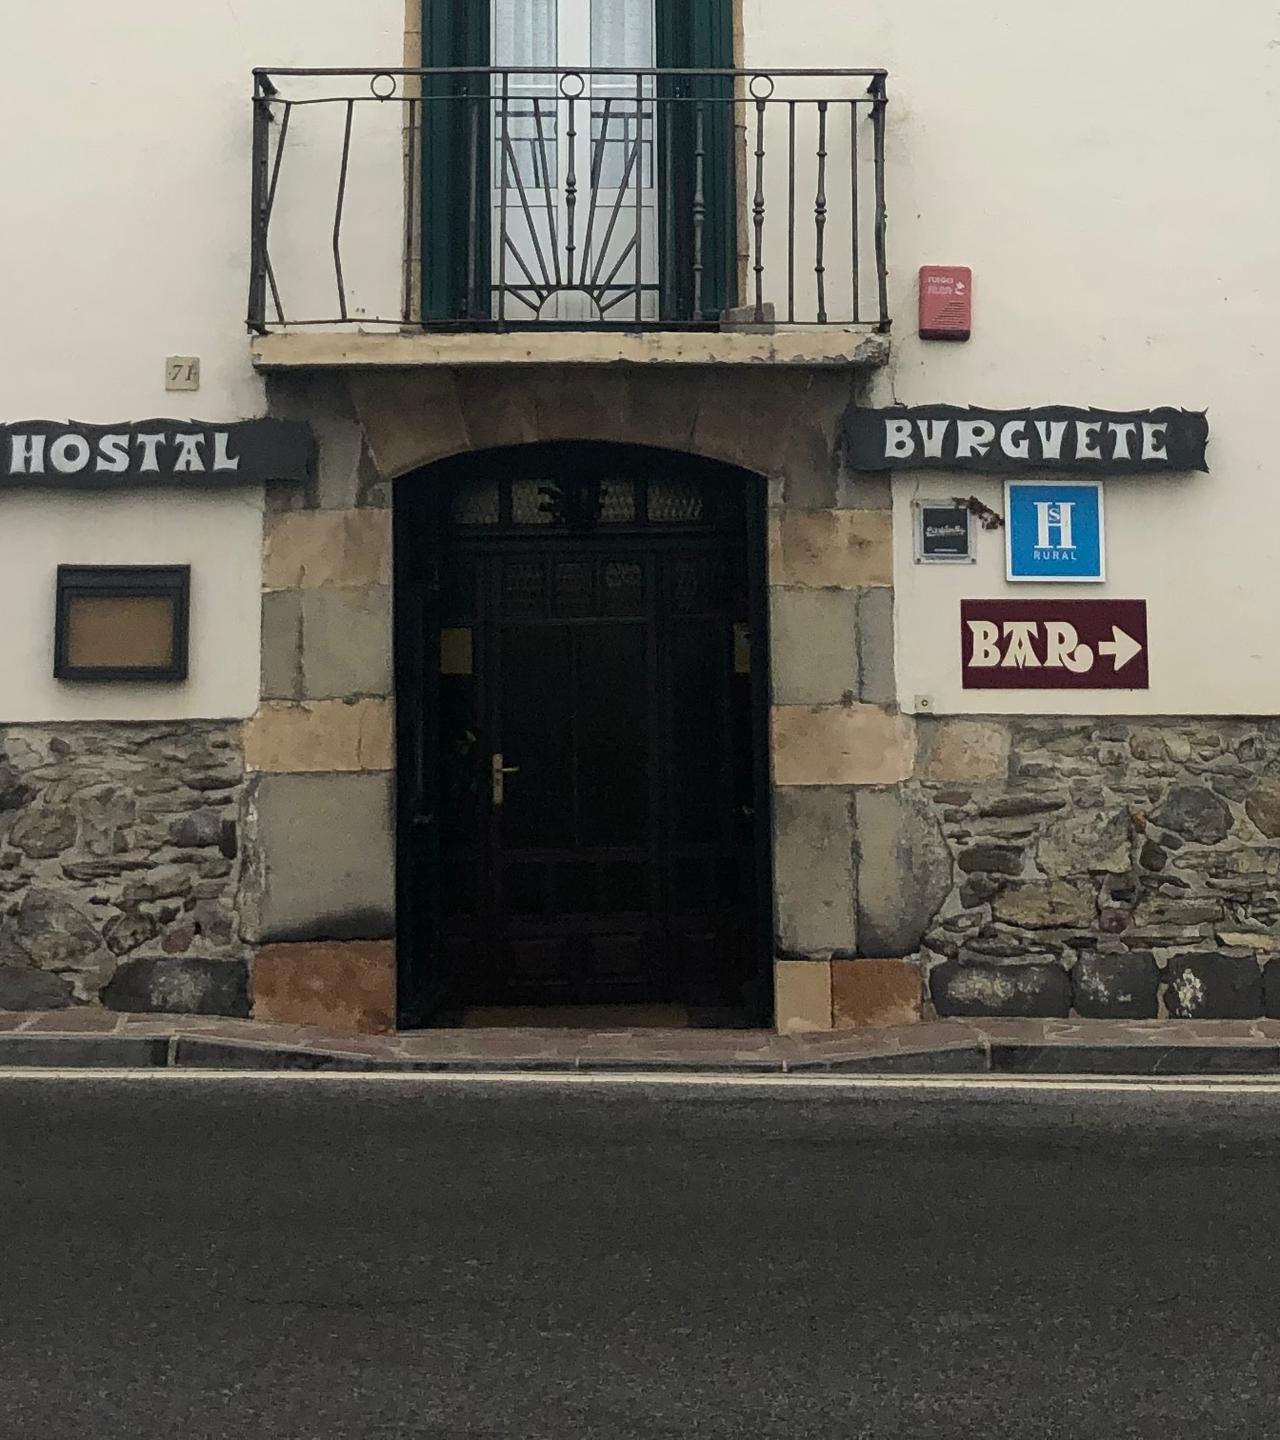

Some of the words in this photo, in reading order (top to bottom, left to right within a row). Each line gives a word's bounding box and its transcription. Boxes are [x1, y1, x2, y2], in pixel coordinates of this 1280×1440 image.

[170, 364, 194, 381] 71
[8, 432, 241, 474] HOSTAL
[1033, 550, 1078, 561] RURAL
[966, 620, 1094, 674] BAR
